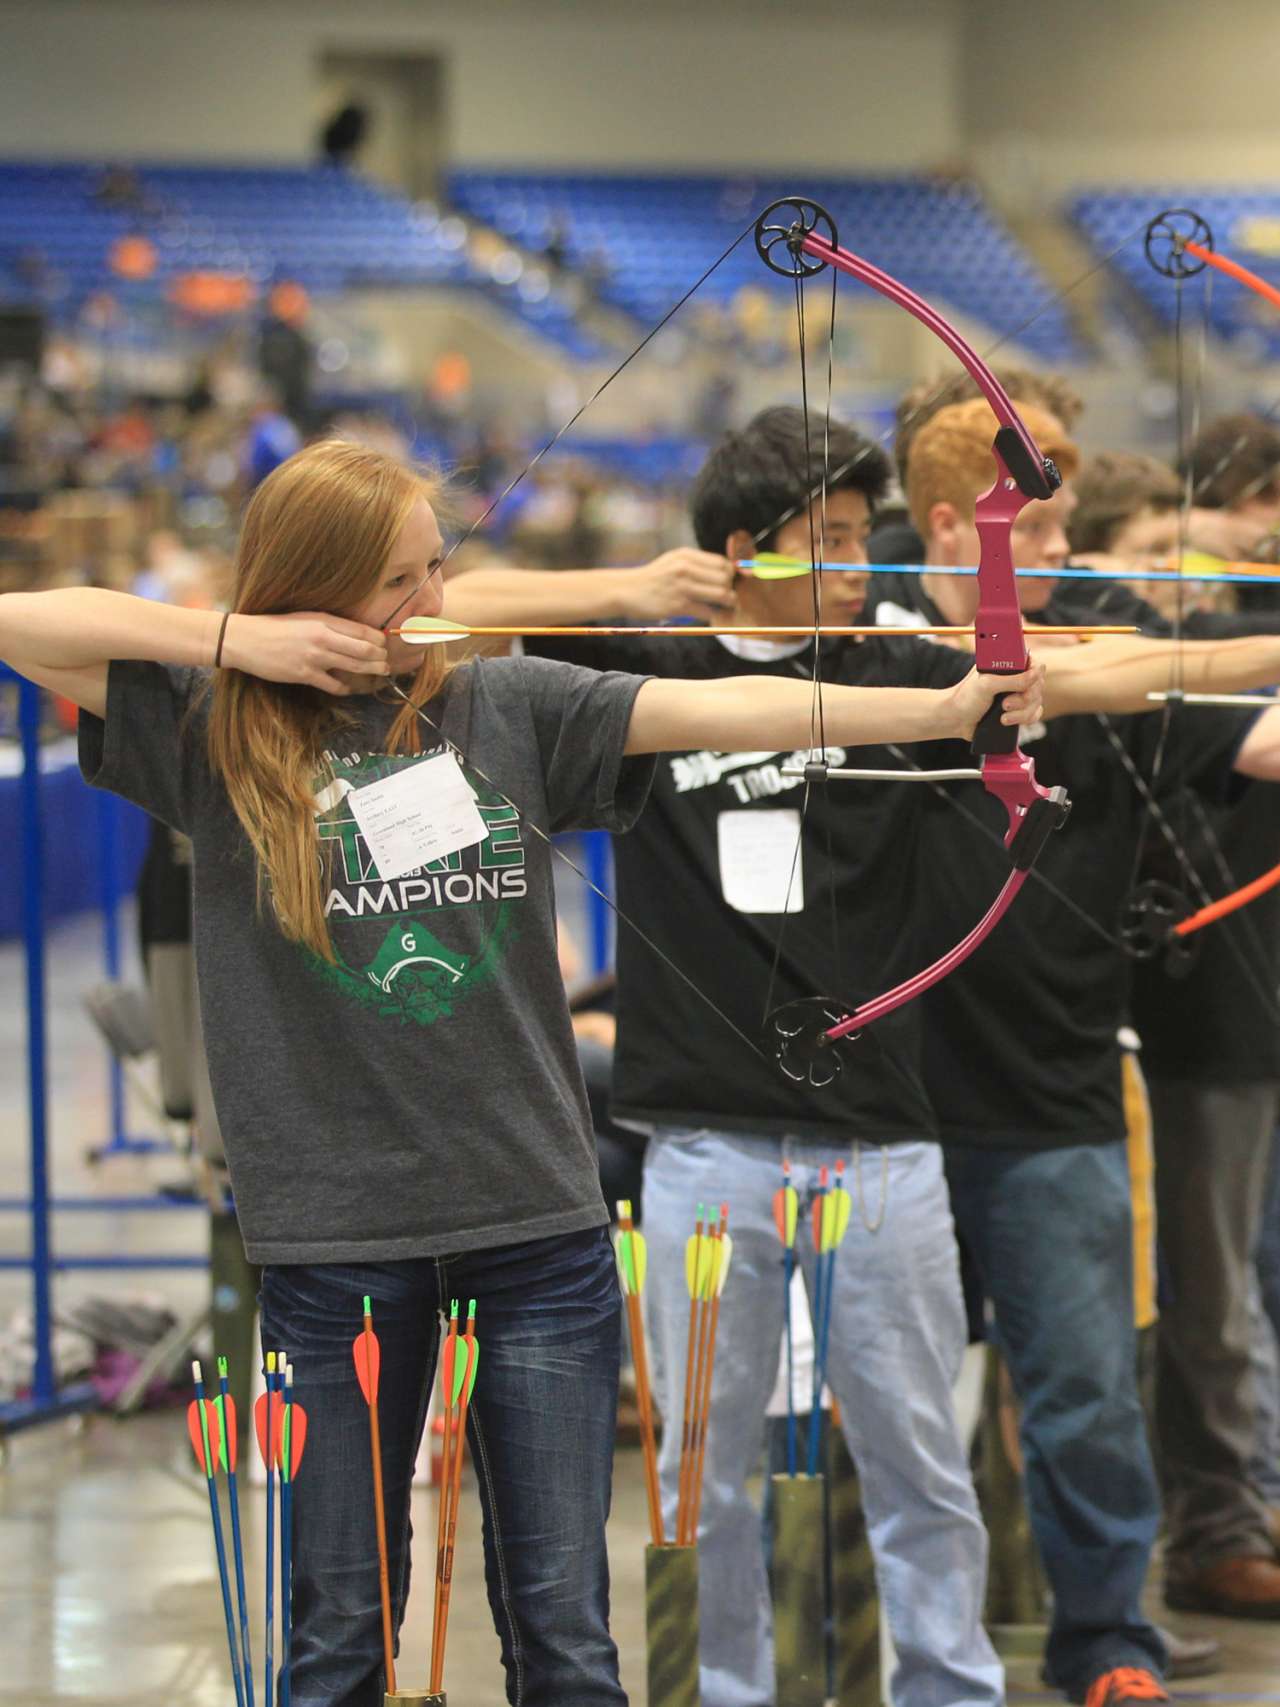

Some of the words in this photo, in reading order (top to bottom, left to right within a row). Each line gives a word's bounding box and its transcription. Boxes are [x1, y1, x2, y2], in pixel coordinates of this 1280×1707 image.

[726, 746, 848, 803] TROS
[324, 868, 528, 917] AMPIONS
[401, 932, 417, 952] G
